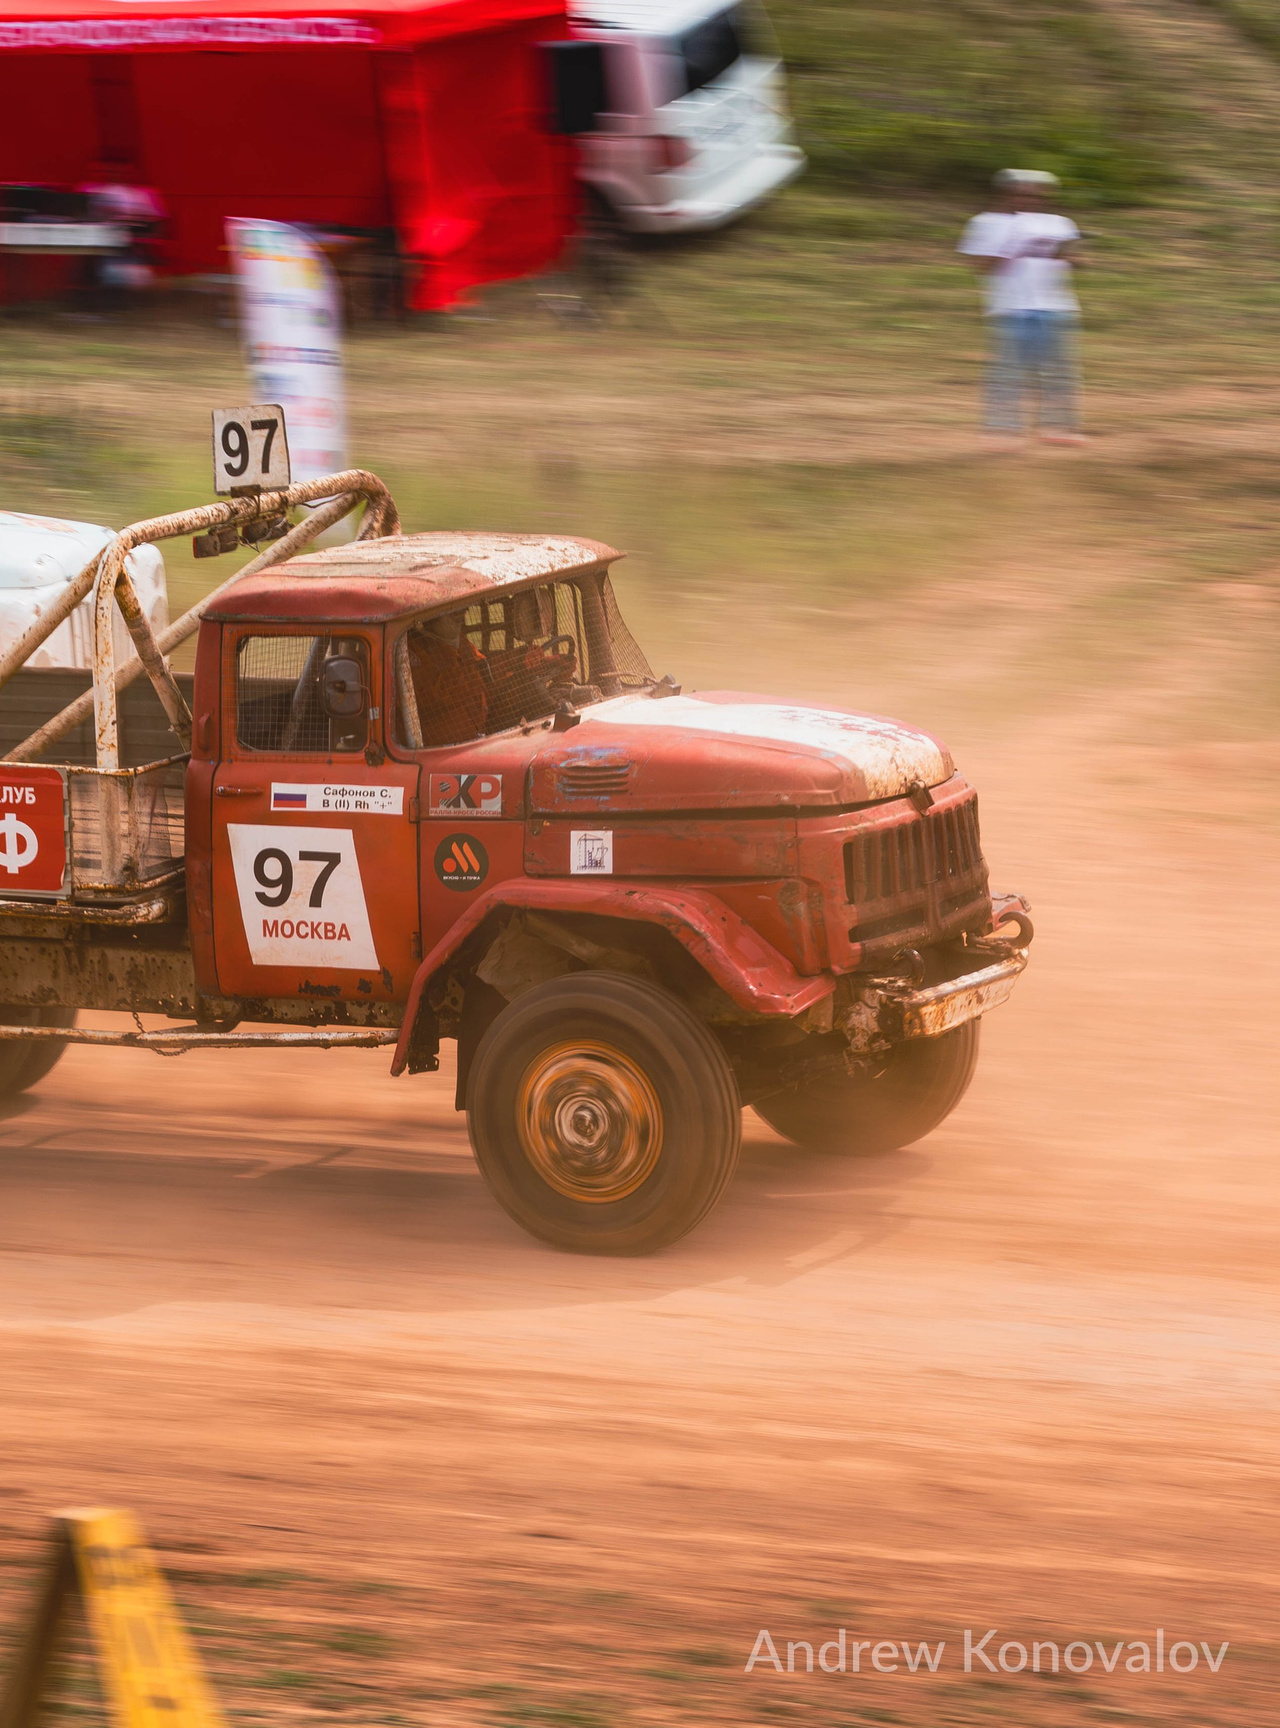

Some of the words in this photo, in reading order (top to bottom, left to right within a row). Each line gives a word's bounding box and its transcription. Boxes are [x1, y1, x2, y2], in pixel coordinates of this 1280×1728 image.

[221, 418, 278, 477] 97
[323, 786, 376, 799] Сафонов
[380, 788, 392, 799] С.
[355, 800, 369, 810] Rh
[253, 847, 341, 908] 97
[262, 919, 351, 941] МОСКВА
